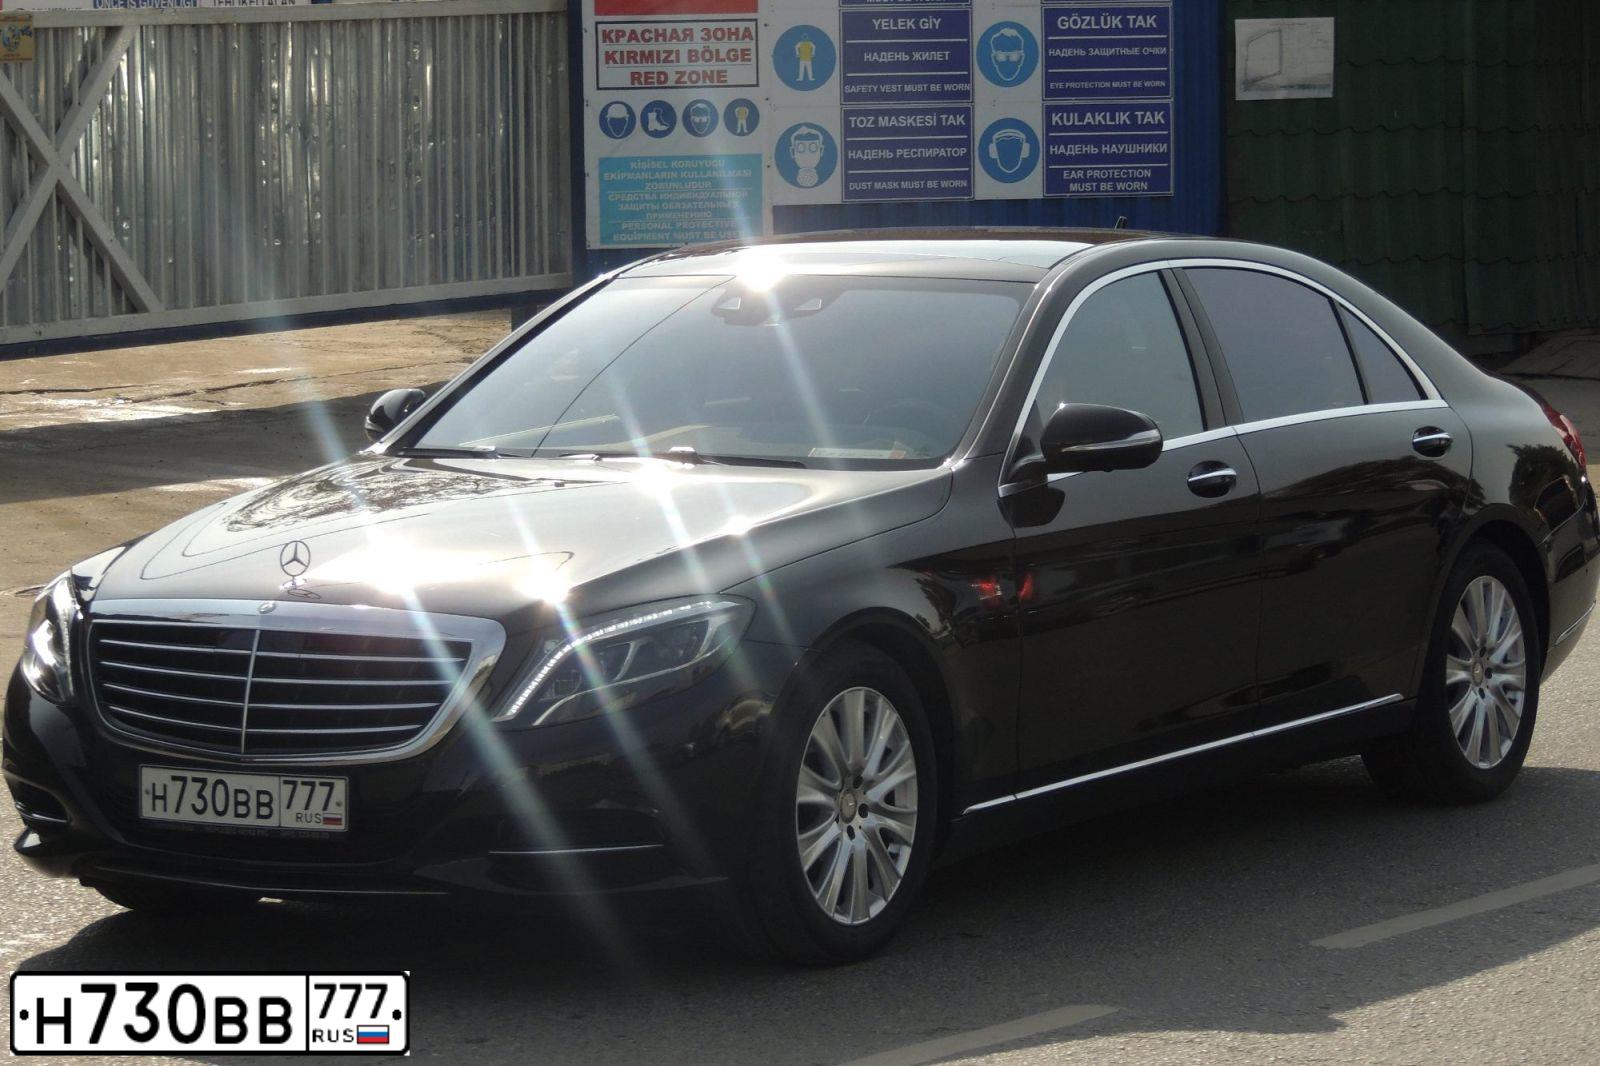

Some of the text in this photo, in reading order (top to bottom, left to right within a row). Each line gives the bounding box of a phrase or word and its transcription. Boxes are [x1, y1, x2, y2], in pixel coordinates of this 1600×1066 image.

[872, 16, 941, 30] YELEK GİY
[1057, 13, 1157, 29] GÖZLÜK TAK
[602, 27, 754, 43] КРАСНАЯ ЗОНА
[605, 46, 752, 65] KIRMIZI BÖLGE
[864, 51, 951, 63] НАДЕНЬ ЖИЛЕТ
[1048, 47, 1167, 57] НАДЕНЬ ЗАЩИТНЫЕ ОЧКИ
[630, 70, 728, 86] RED ZONE
[1065, 81, 1111, 89] PROTECTION
[1133, 80, 1143, 88] BE
[1144, 80, 1166, 88] WORN
[844, 83, 970, 93] SAFETY VEST MUST BE WORN
[848, 113, 966, 128] TOZ MASKESİ TAK
[1051, 111, 1165, 126] KULAKLIK TAK
[848, 147, 967, 160] НАДЕНЬ РЕСПИРАТОР
[1049, 143, 1168, 156] НАДЕНЬ НАУШНИКИ
[1063, 169, 1151, 180] EAR PROTECTION
[849, 180, 968, 191] DUST MASK MUST BE WORN
[1069, 181, 1148, 192] MUST BE WORN
[282, 780, 335, 812] 777
[295, 812, 322, 824] RUS
